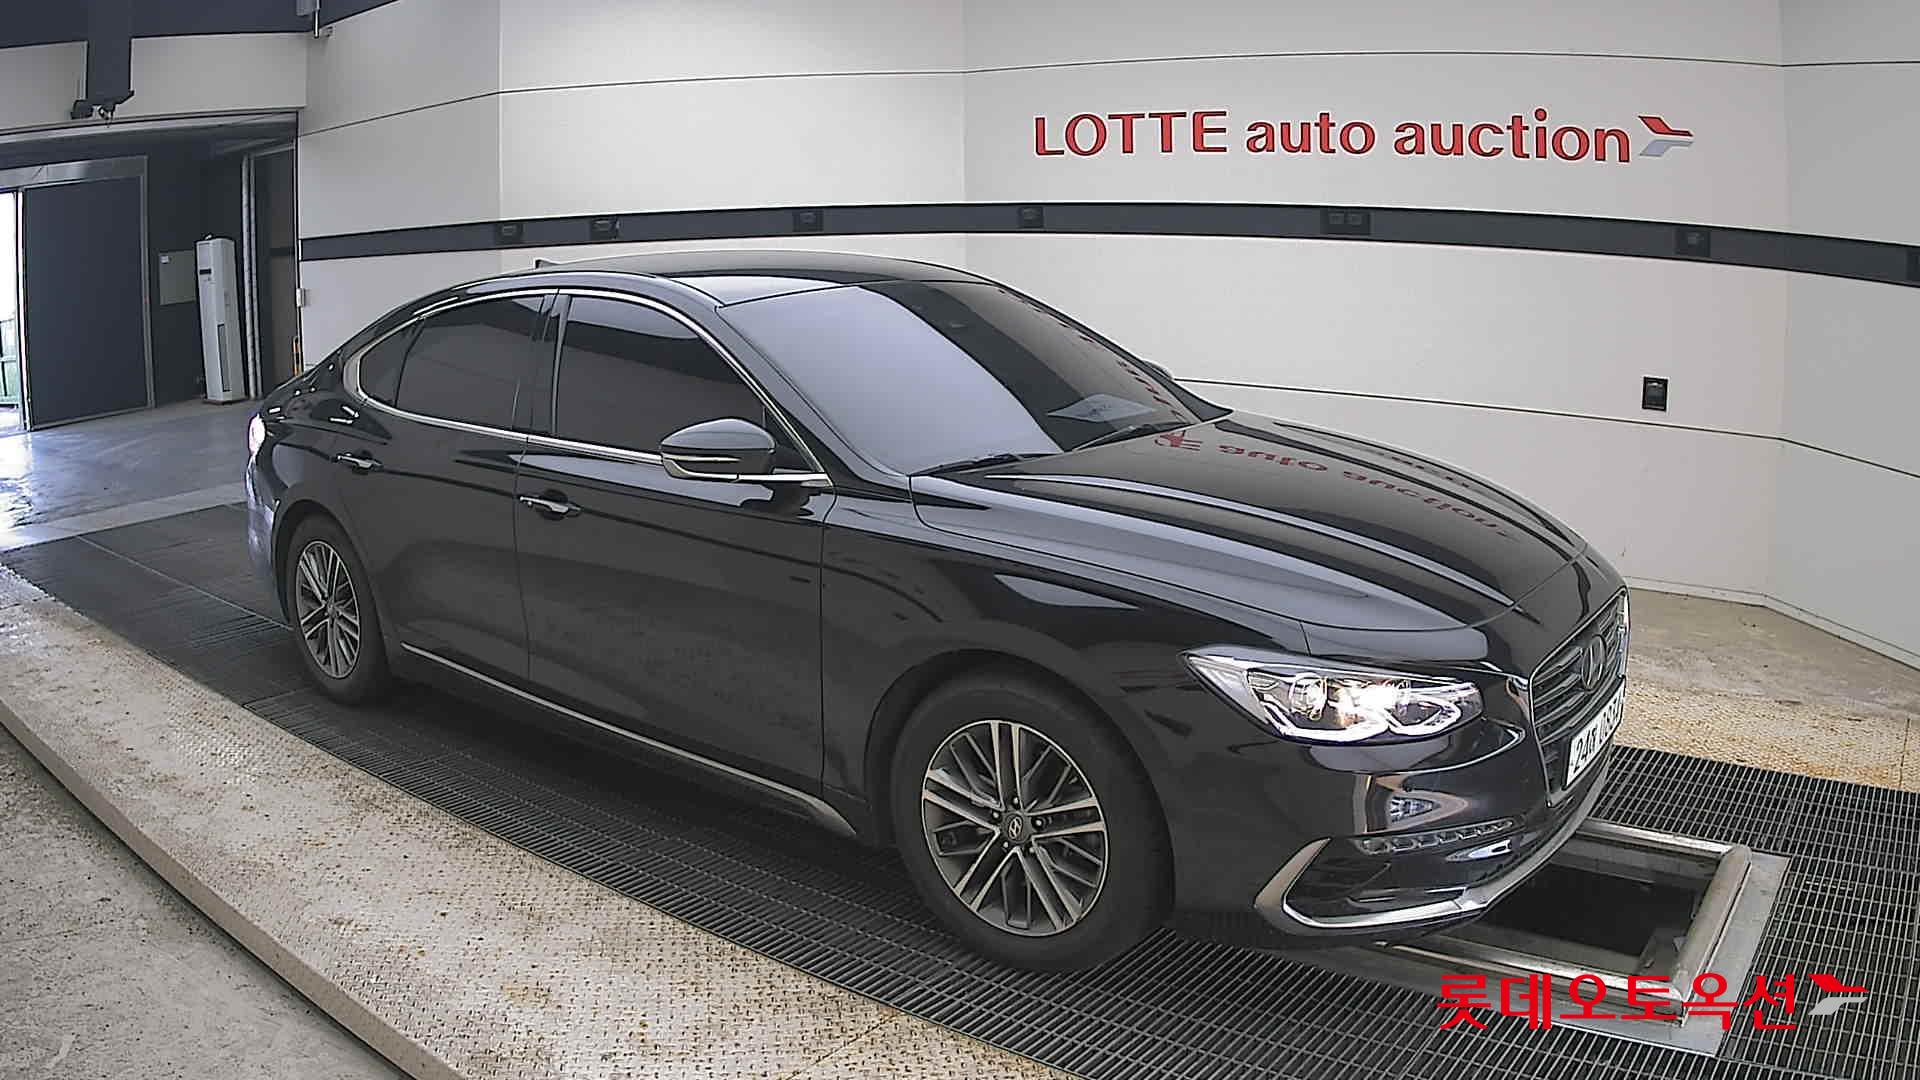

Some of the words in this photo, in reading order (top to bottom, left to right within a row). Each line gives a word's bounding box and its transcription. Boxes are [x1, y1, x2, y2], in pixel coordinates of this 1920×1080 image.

[1034, 110, 1227, 157] LOTTE
[1246, 112, 1377, 156] auto
[1393, 107, 1632, 163] auction
